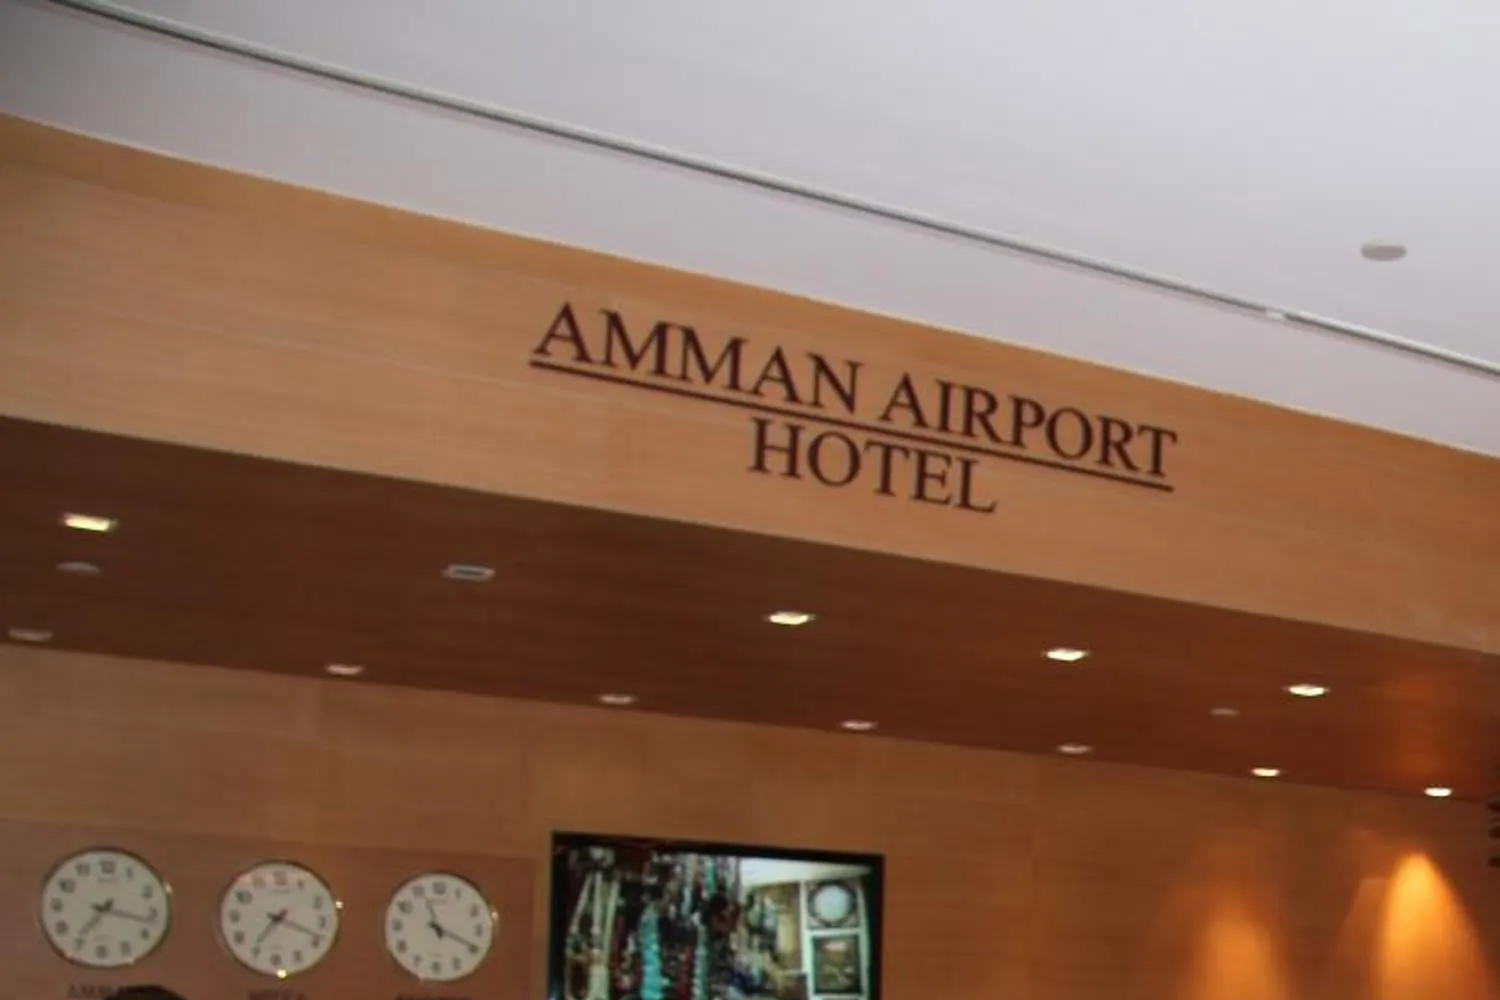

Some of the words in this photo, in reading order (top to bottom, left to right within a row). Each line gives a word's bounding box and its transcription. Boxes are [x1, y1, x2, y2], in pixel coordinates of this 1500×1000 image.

[532, 301, 864, 415] AMMAN
[878, 372, 1178, 479] AIRPORT
[748, 416, 997, 515] HOTEL
